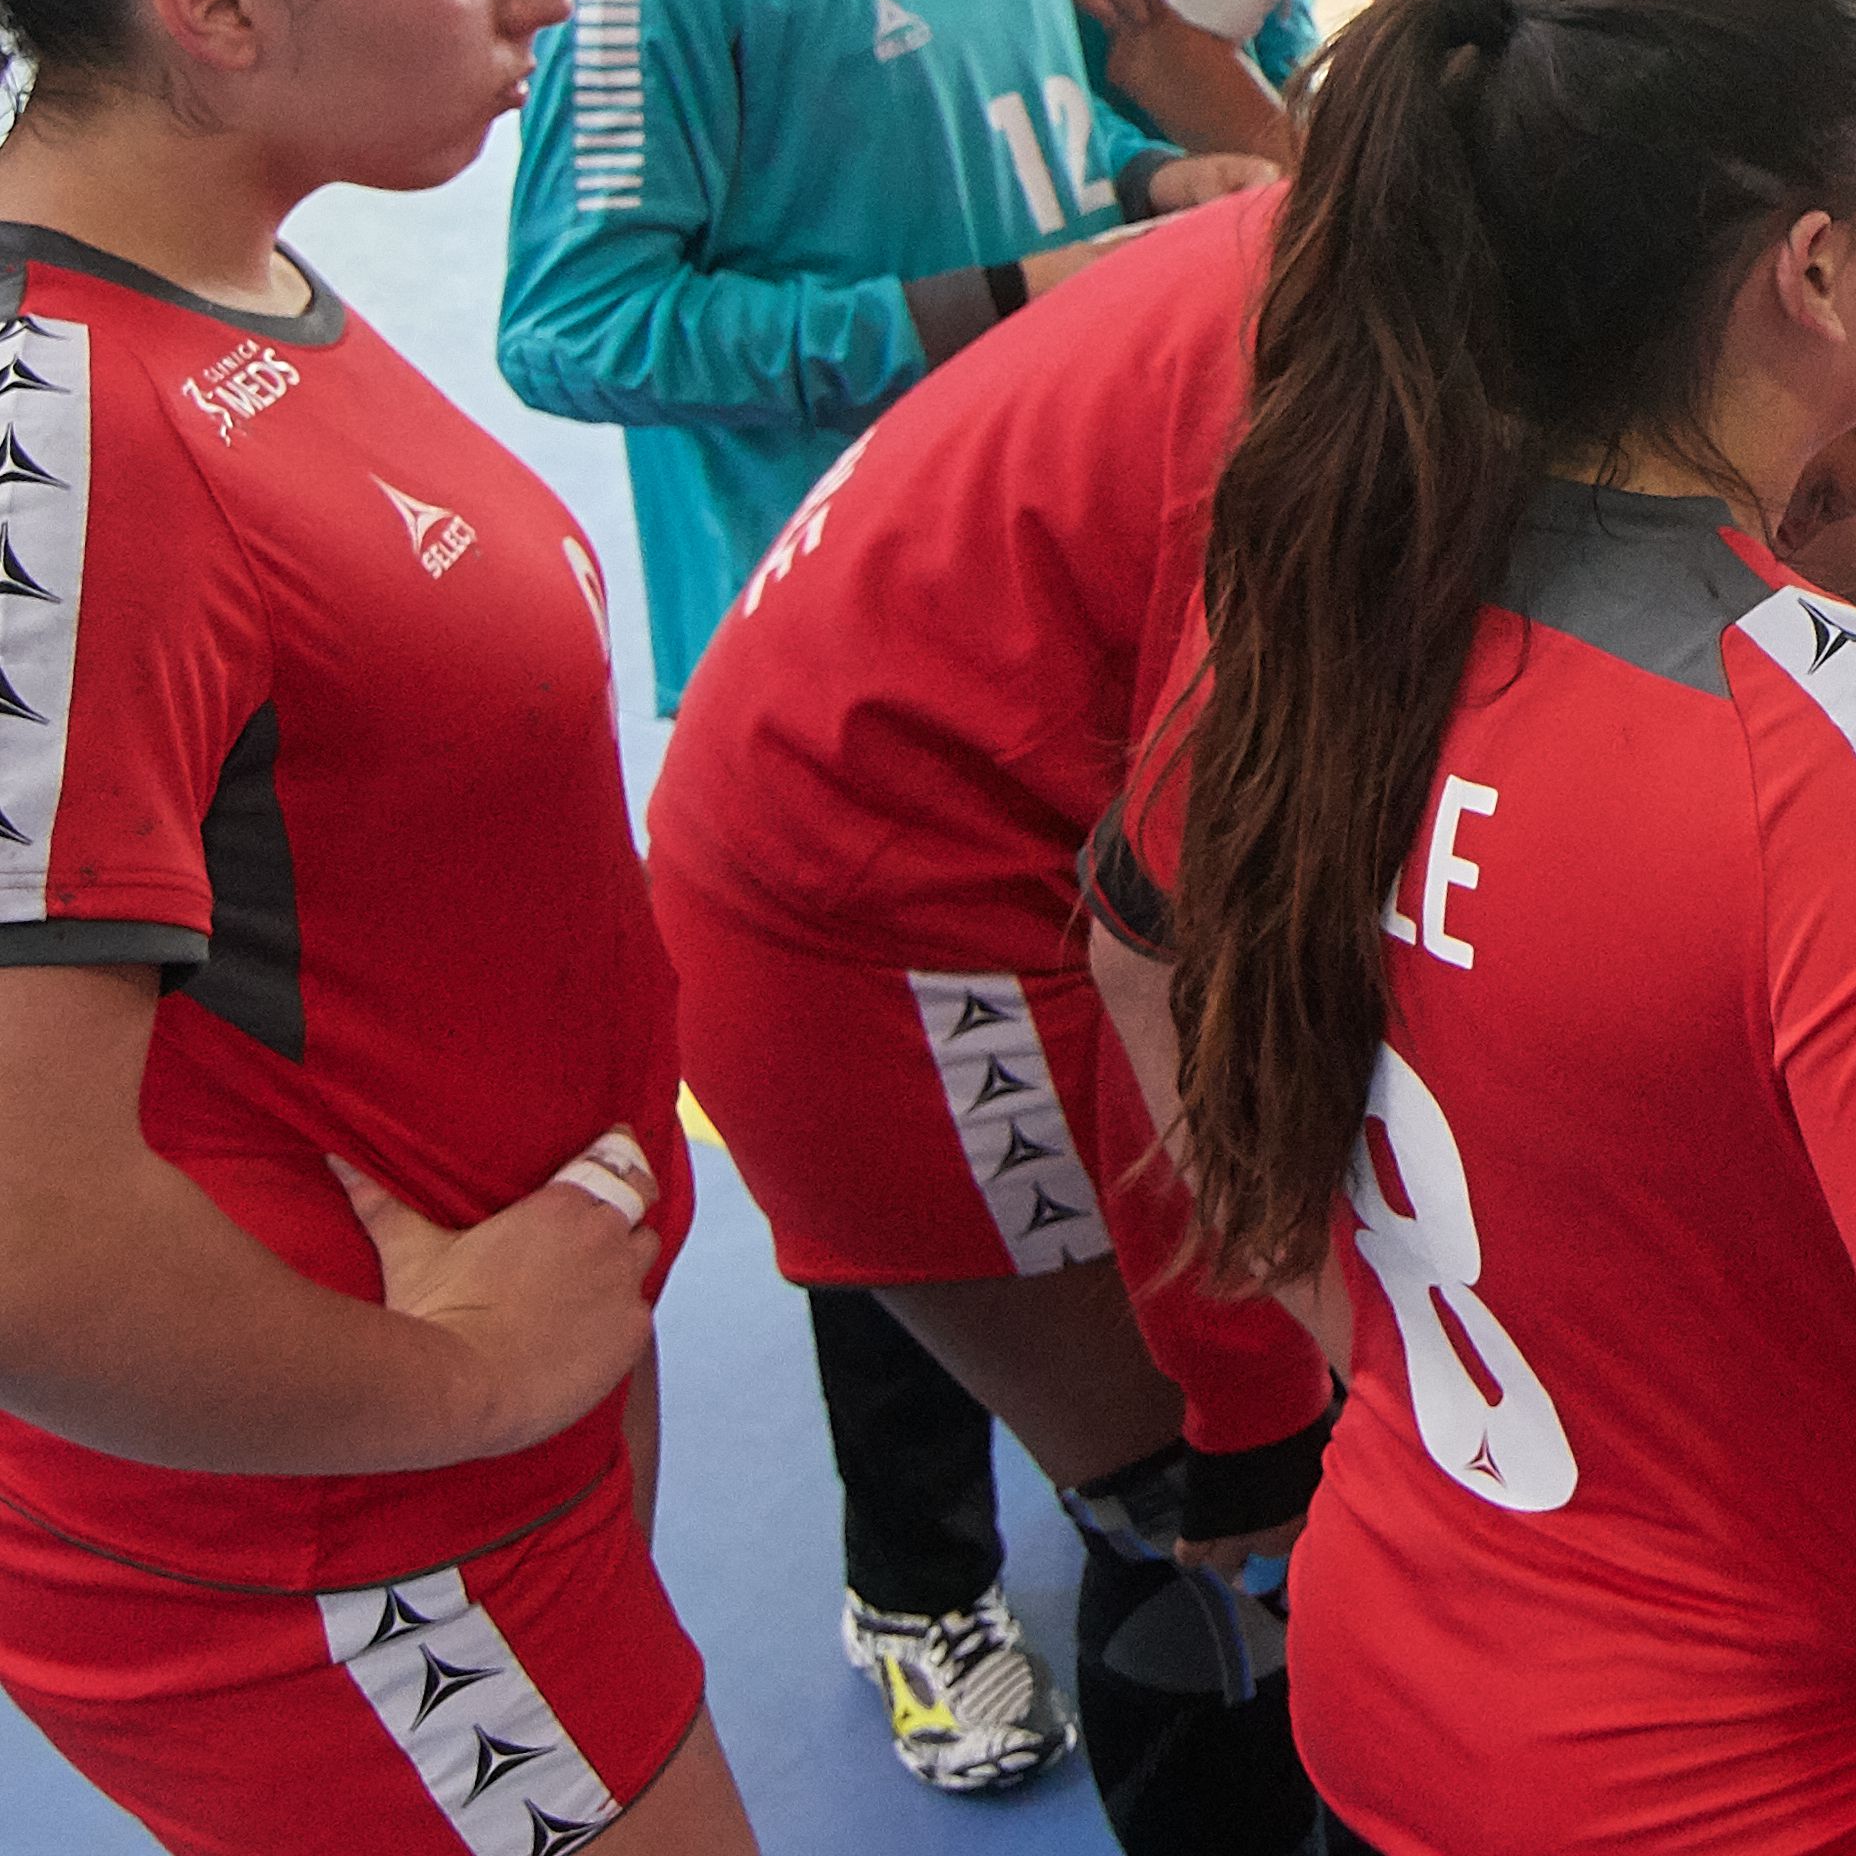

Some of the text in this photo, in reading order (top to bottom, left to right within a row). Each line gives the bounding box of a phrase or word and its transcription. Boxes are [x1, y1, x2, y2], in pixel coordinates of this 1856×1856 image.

[989, 74, 1117, 236] 12
[213, 346, 300, 419] MEDS
[420, 514, 479, 580] SELECT
[1345, 1041, 1578, 1512] 8
